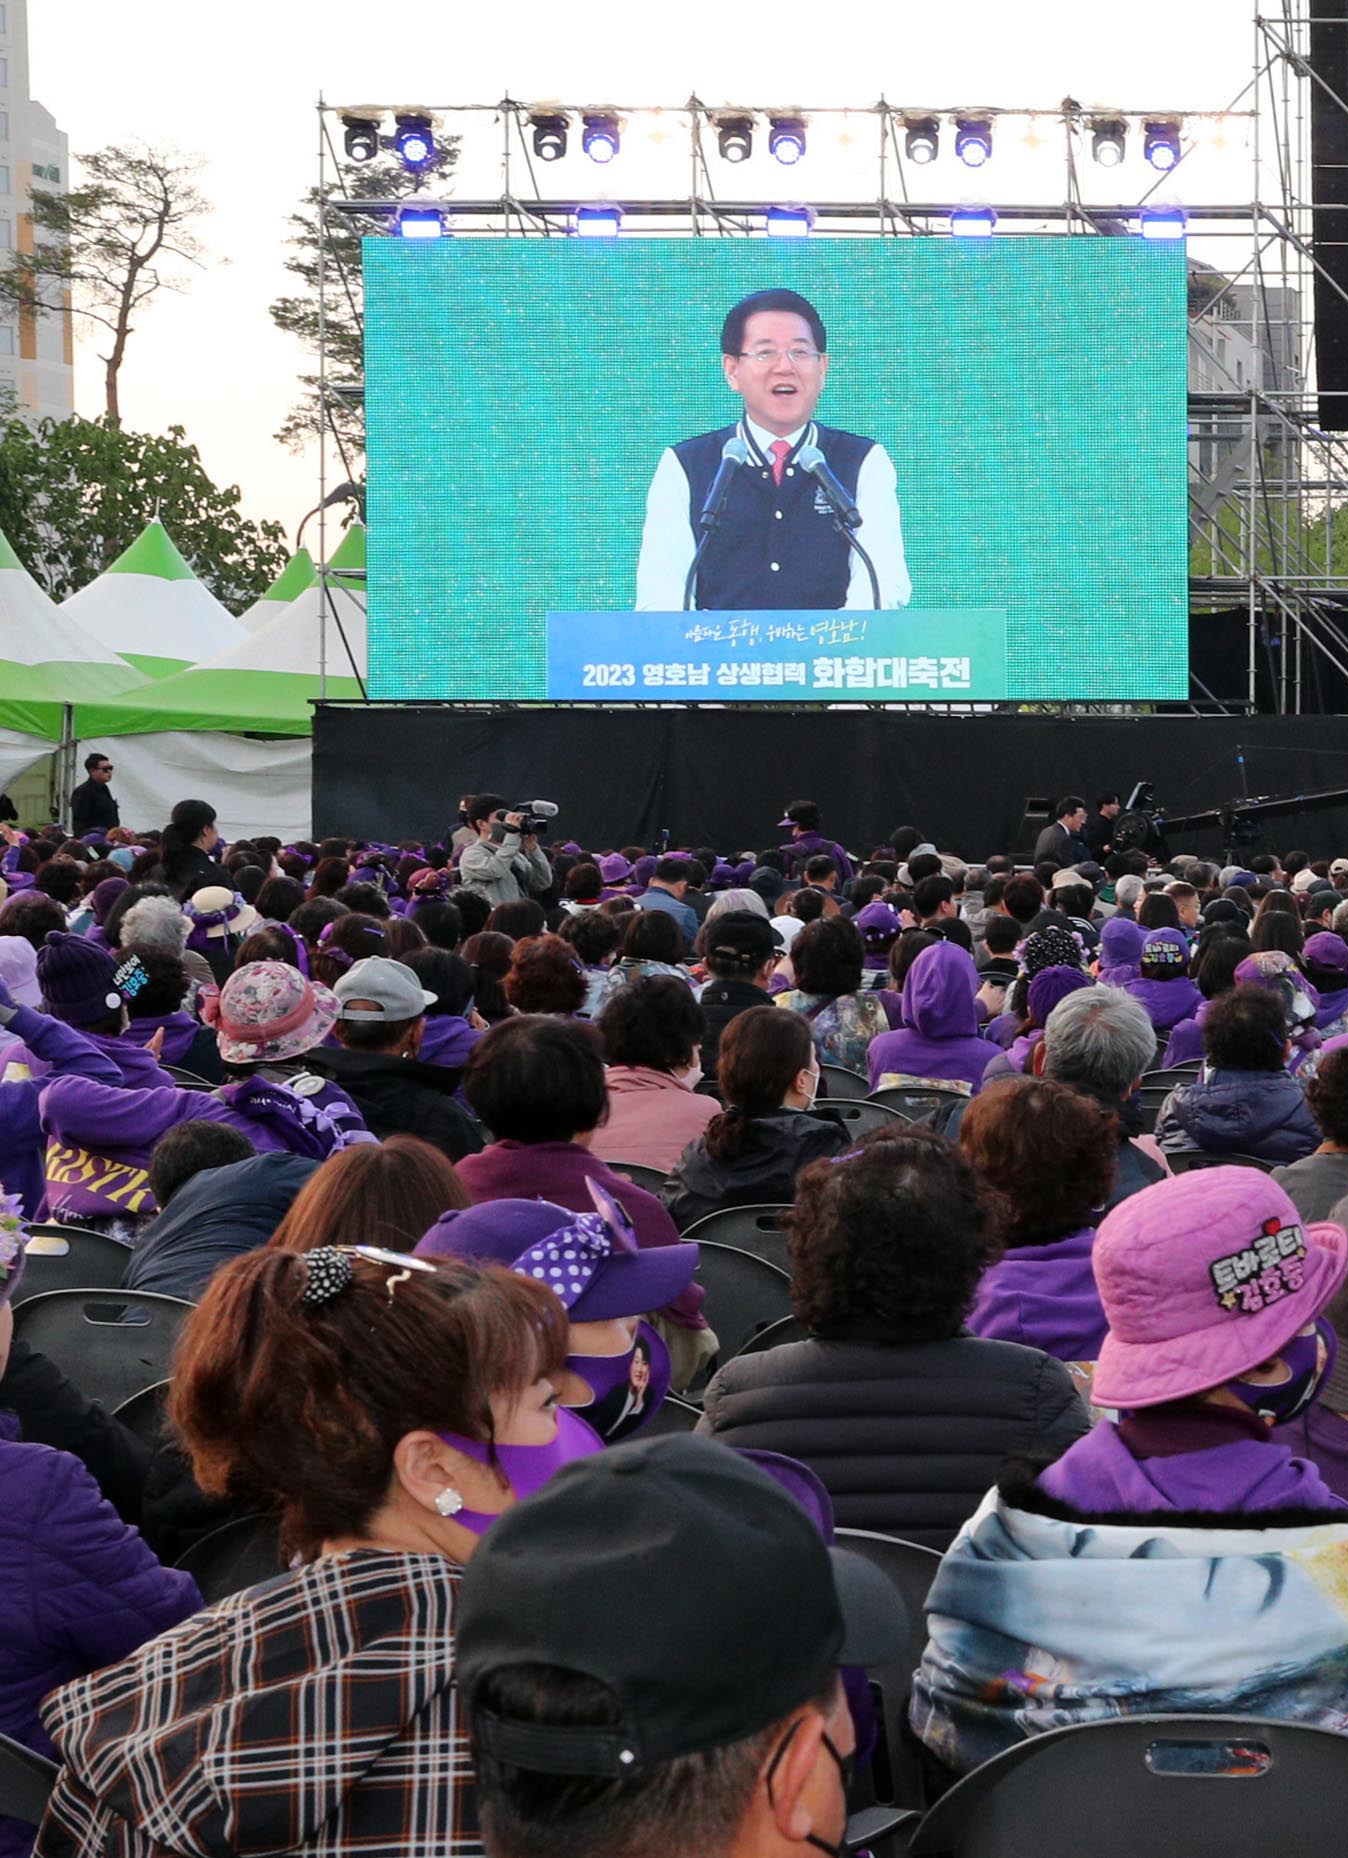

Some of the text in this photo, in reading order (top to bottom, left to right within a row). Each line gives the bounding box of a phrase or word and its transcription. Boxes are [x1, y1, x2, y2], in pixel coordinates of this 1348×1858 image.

[811, 617, 867, 645] 영호남!
[583, 656, 971, 690] 2023 영호남 상생협력 화합대축전
[121, 968, 148, 997] 김호중
[1212, 1226, 1304, 1293] 트바로티
[1233, 1254, 1304, 1312] 김호중
